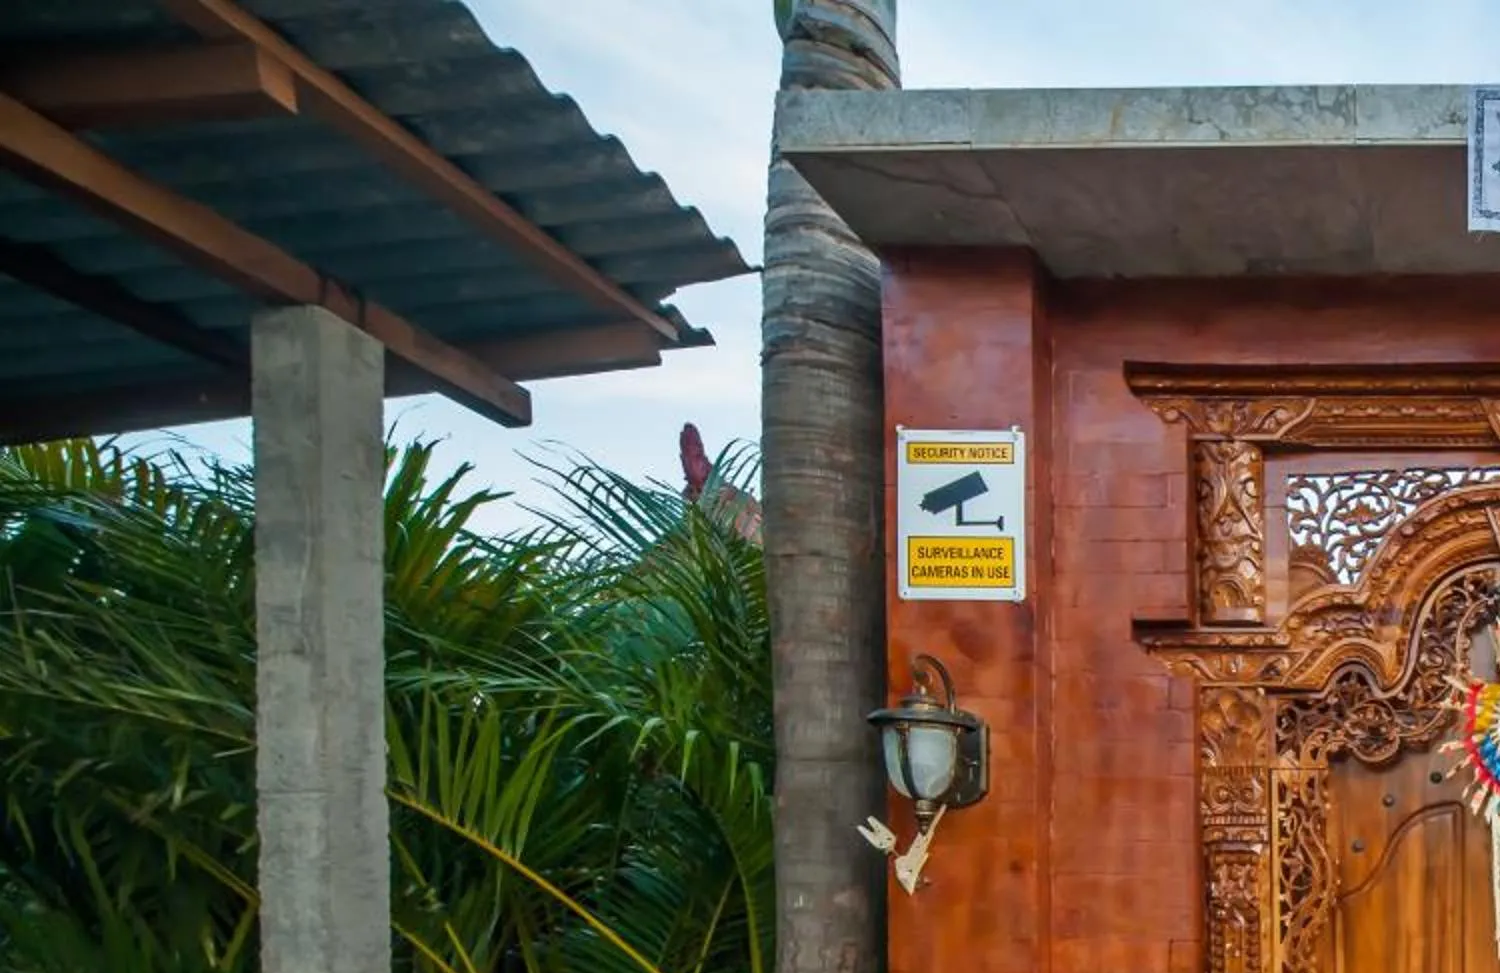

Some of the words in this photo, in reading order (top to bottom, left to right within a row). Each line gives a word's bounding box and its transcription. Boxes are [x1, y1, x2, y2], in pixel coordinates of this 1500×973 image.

[913, 447, 966, 459] SECURITY
[967, 447, 1008, 459] NOTICE
[917, 546, 1004, 560] SURVEILLANCE
[911, 565, 969, 578] CAMERAS
[971, 565, 984, 578] IN
[987, 565, 1010, 579] USE
